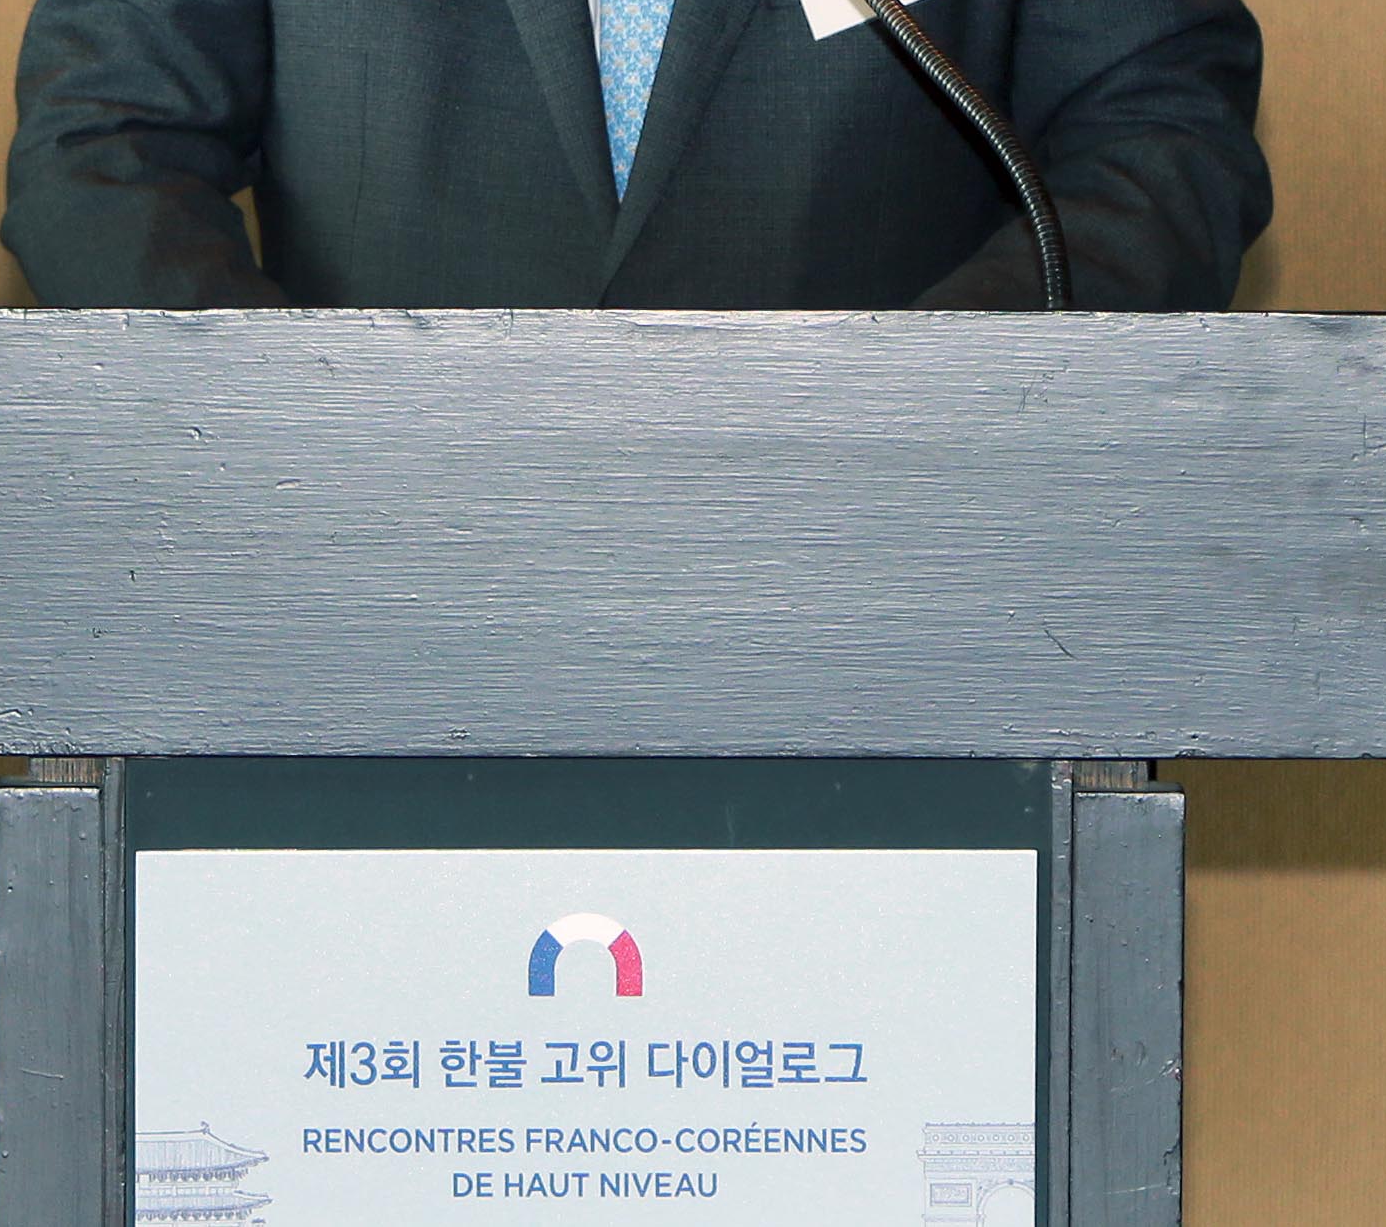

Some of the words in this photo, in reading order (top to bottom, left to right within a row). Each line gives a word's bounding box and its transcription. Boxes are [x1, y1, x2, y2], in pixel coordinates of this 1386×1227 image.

[303, 1040, 420, 1088] 제3회
[439, 1040, 527, 1088] 한불
[540, 1040, 627, 1088] 고위
[647, 1040, 868, 1088] 다이얼로그
[303, 1128, 515, 1154] RENCONTRES
[526, 1121, 867, 1154] FRANCO-CORÉENNES
[453, 1172, 494, 1198] DE
[504, 1172, 590, 1198] HAUT
[600, 1172, 718, 1198] NIVEAU
